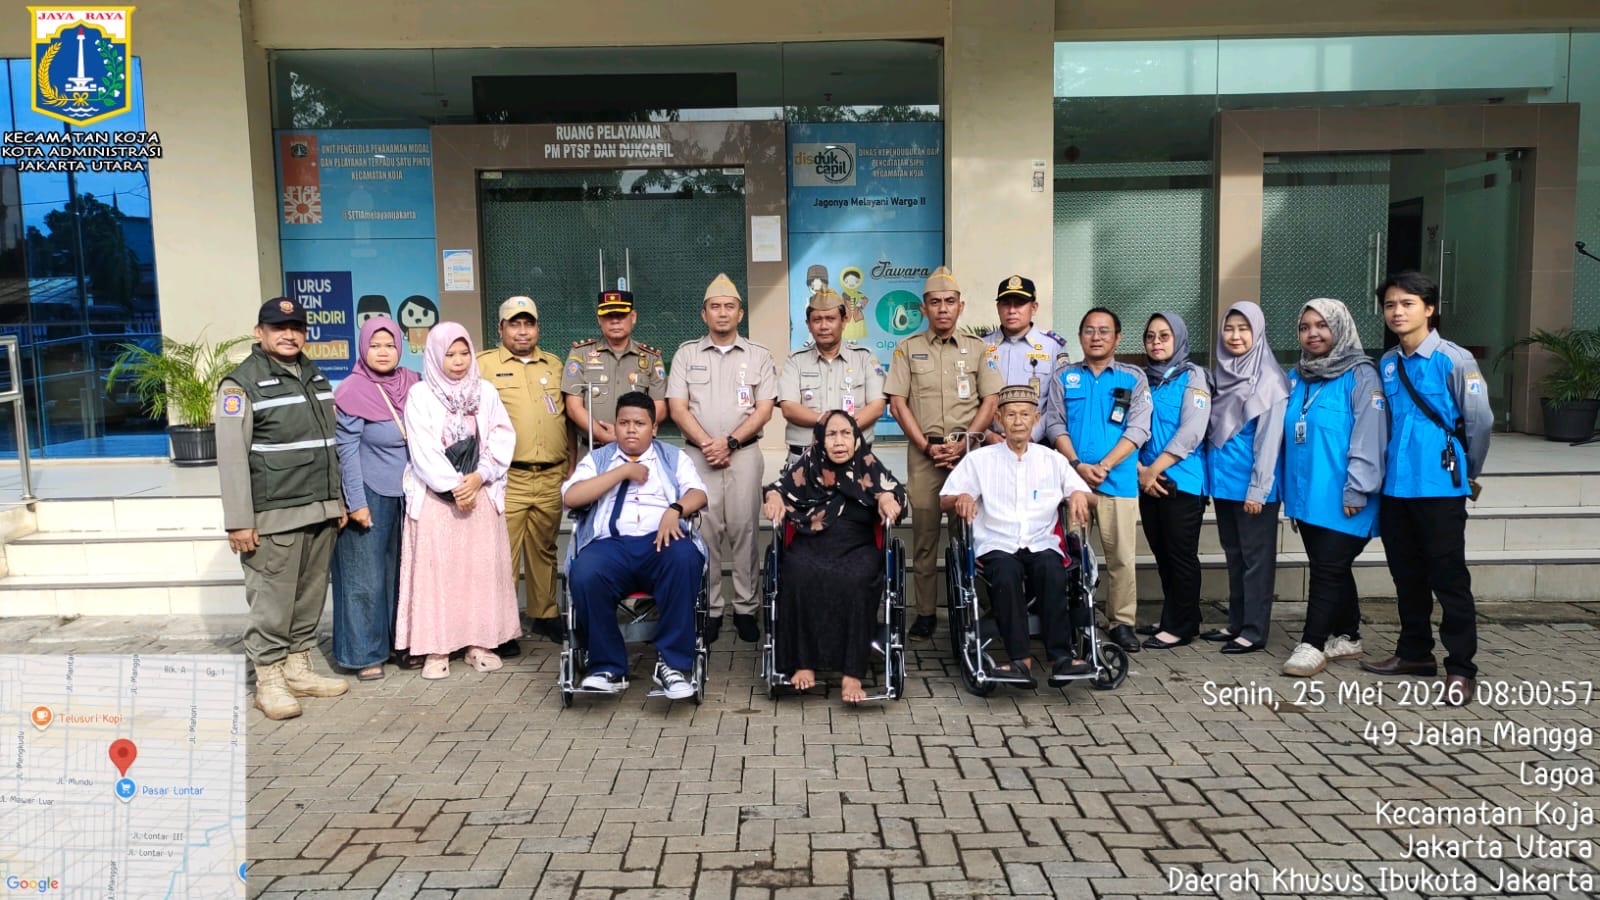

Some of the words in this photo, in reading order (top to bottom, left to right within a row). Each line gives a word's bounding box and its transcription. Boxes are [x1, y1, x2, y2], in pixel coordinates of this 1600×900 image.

[556, 126, 593, 140] RUANG
[597, 125, 661, 139] PELAYANAN
[544, 144, 560, 158] PM
[563, 144, 590, 158] PTSP
[594, 143, 616, 158] DAN
[619, 143, 674, 157] DUKCAPIL
[815, 162, 846, 177] capil
[813, 198, 849, 208] Jagonya
[851, 198, 888, 208] Melayani
[890, 197, 918, 207] Warga
[298, 279, 332, 293] URUS
[305, 311, 346, 325] ENDIRI
[305, 326, 321, 340] TU
